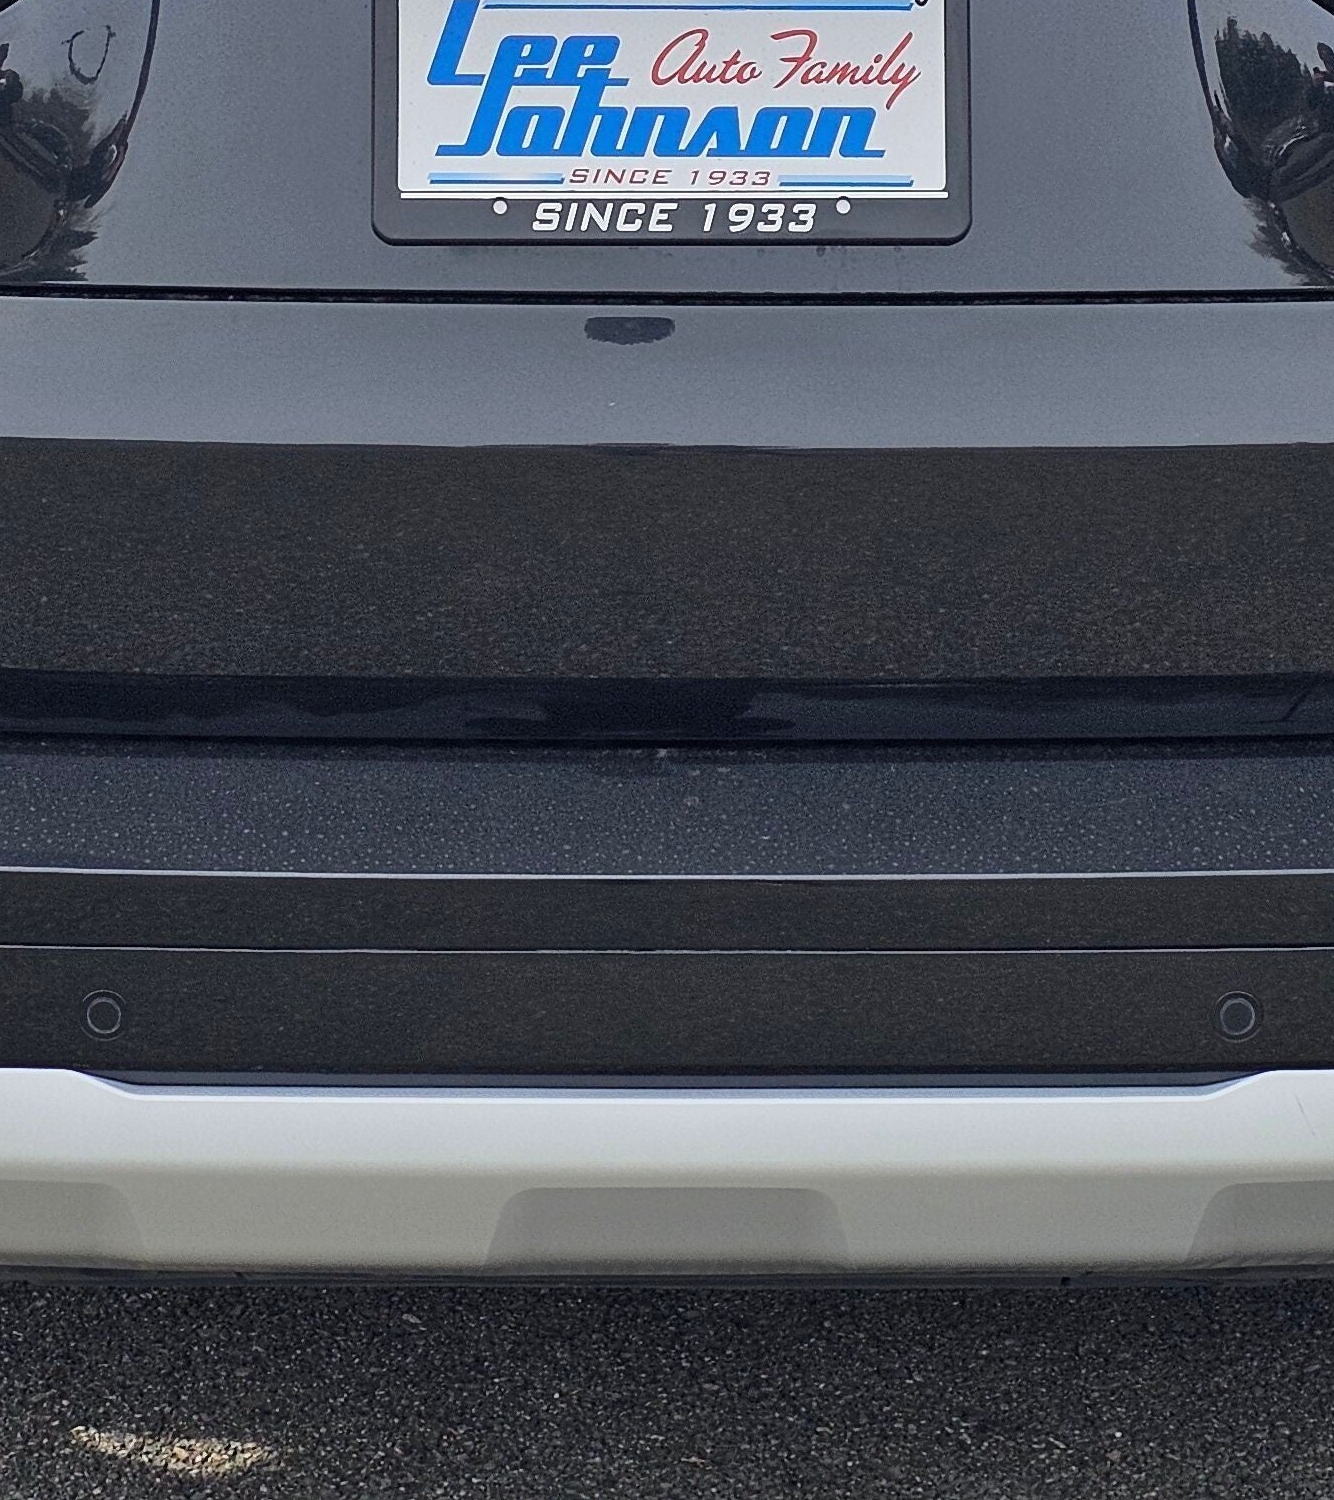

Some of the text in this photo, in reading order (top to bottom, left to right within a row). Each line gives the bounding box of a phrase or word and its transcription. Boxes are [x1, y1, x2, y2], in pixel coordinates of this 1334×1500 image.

[651, 28, 921, 109] Auto Family
[435, 68, 886, 158] Johnson
[569, 168, 770, 187] SINCE 1933
[532, 203, 817, 232] SINCE 1933
